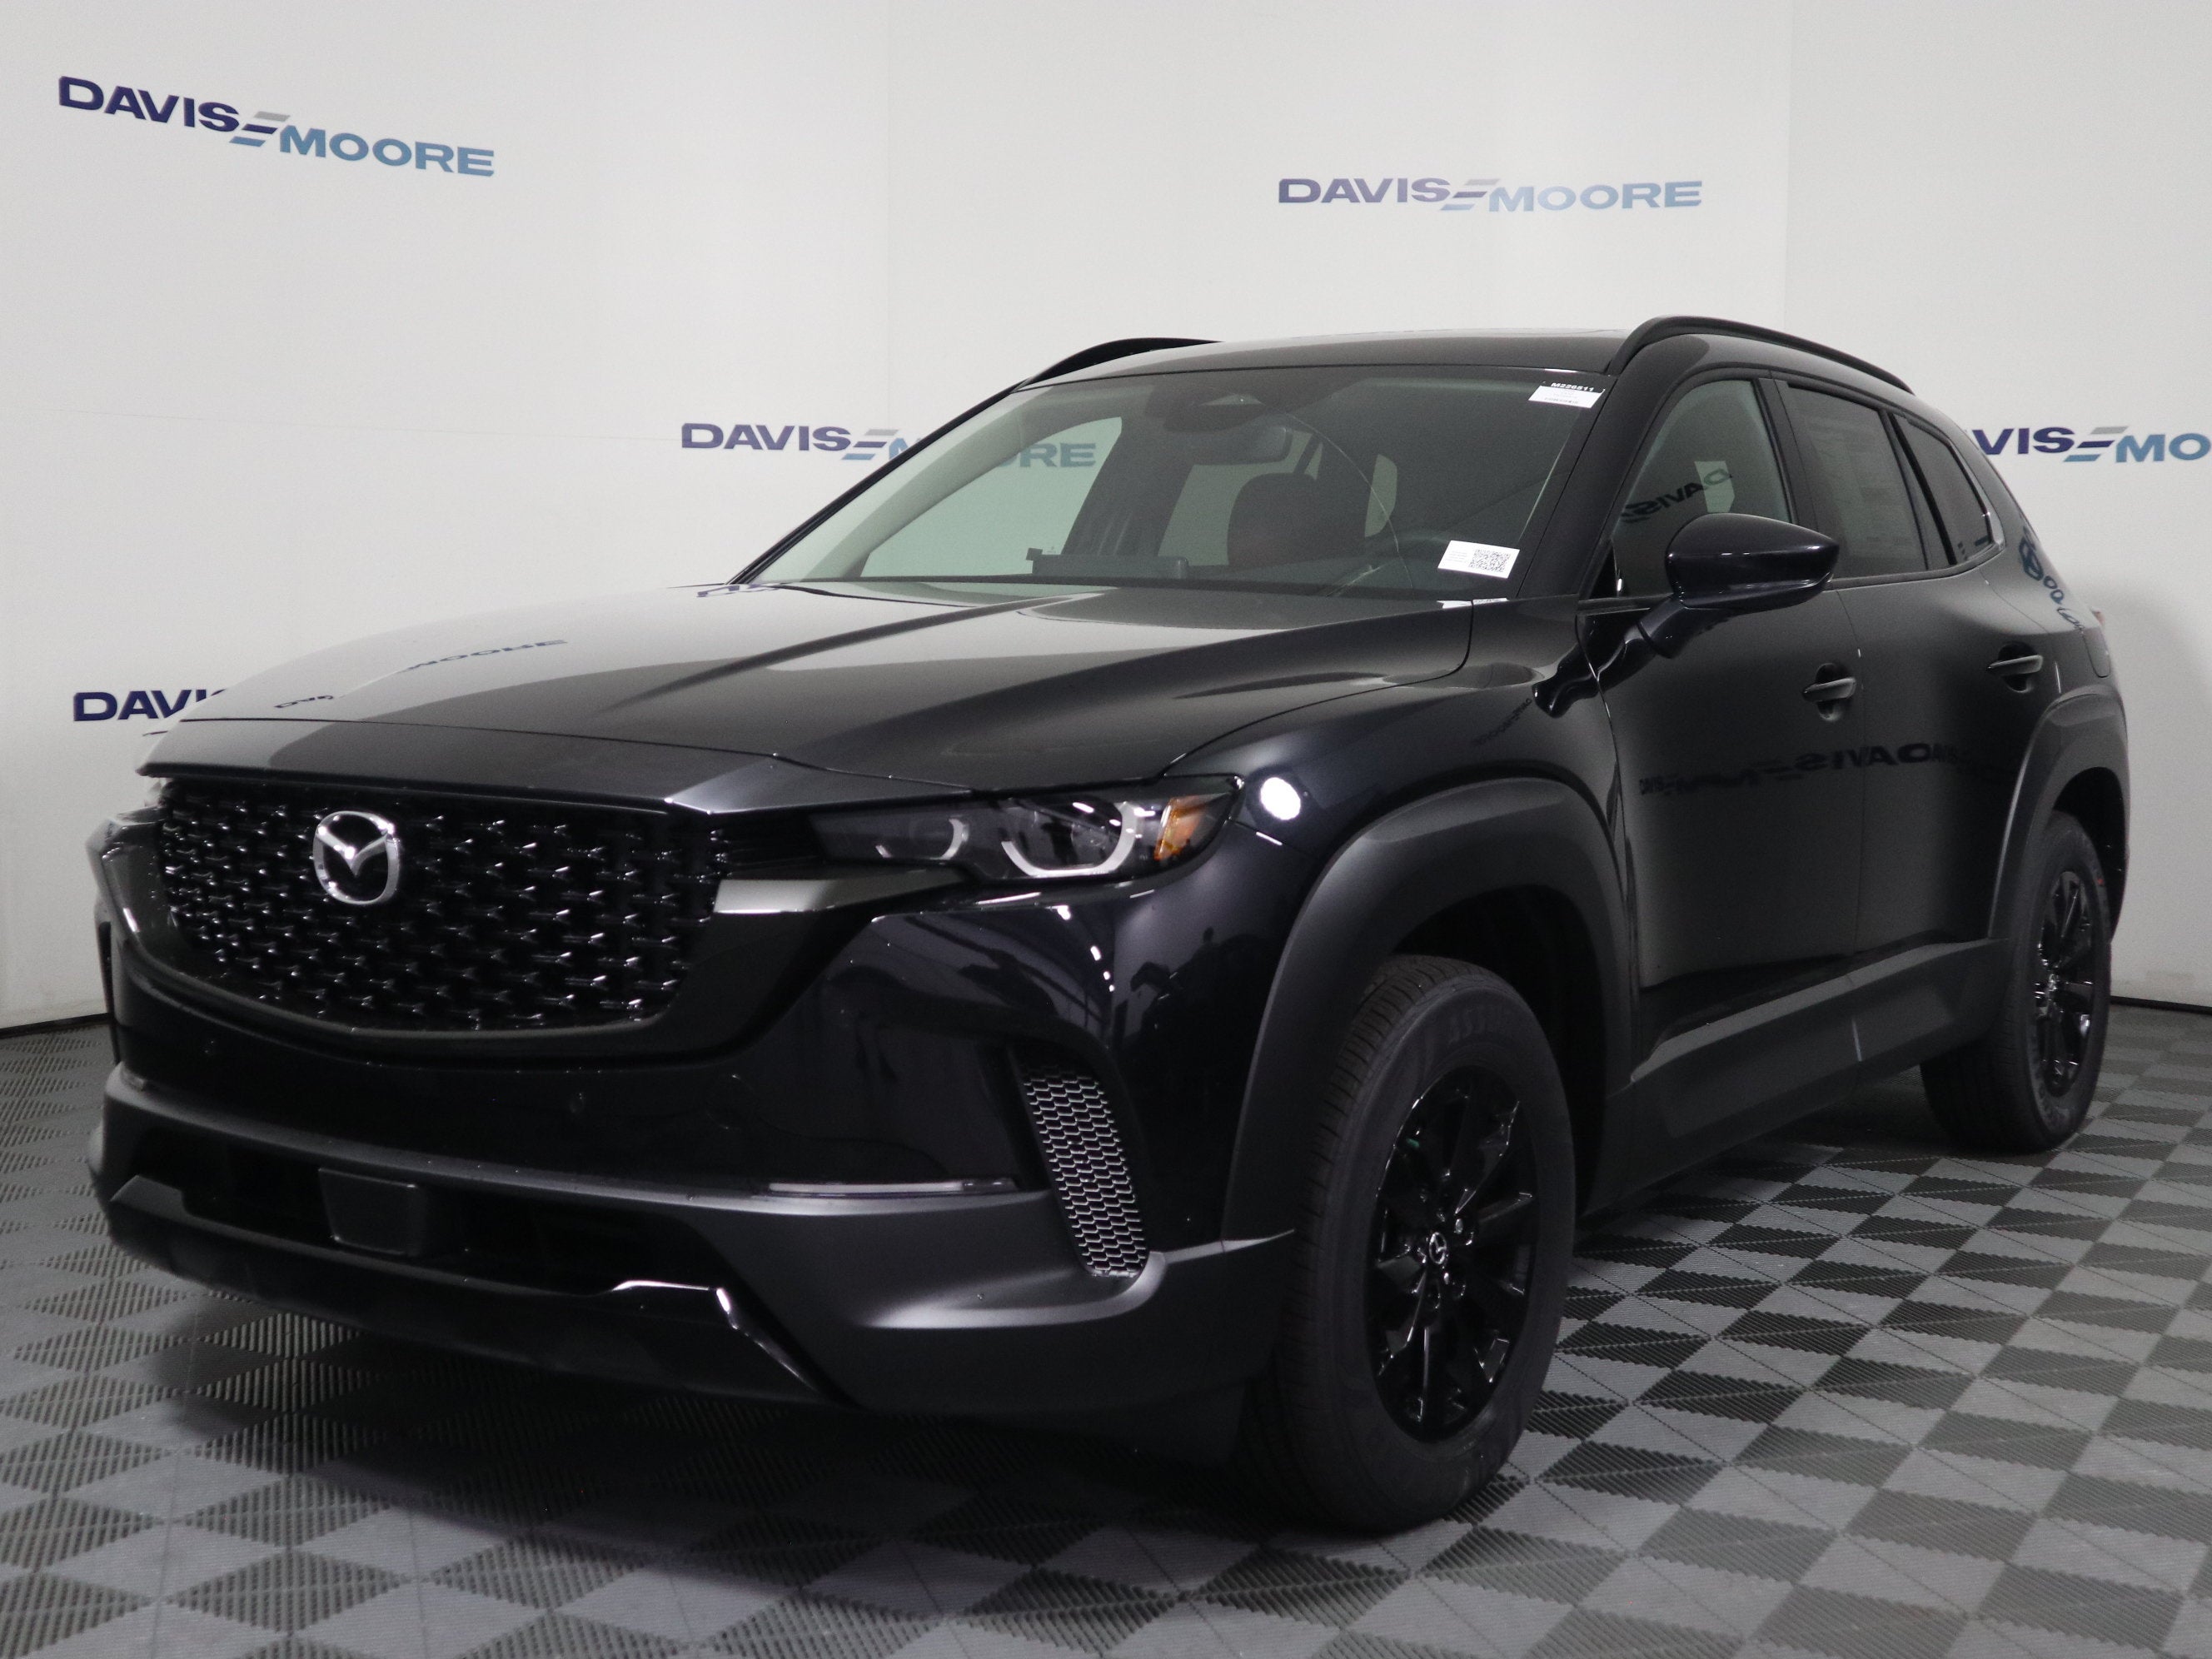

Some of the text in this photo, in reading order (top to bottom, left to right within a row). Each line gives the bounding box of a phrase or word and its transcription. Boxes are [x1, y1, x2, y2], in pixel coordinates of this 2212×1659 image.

[57, 76, 495, 177] DAVIS MOORE
[1278, 177, 1702, 212] DAVIS MOORE
[681, 422, 852, 451] DAVIS
[1970, 426, 2075, 455] VIS
[73, 689, 227, 721] DAV
